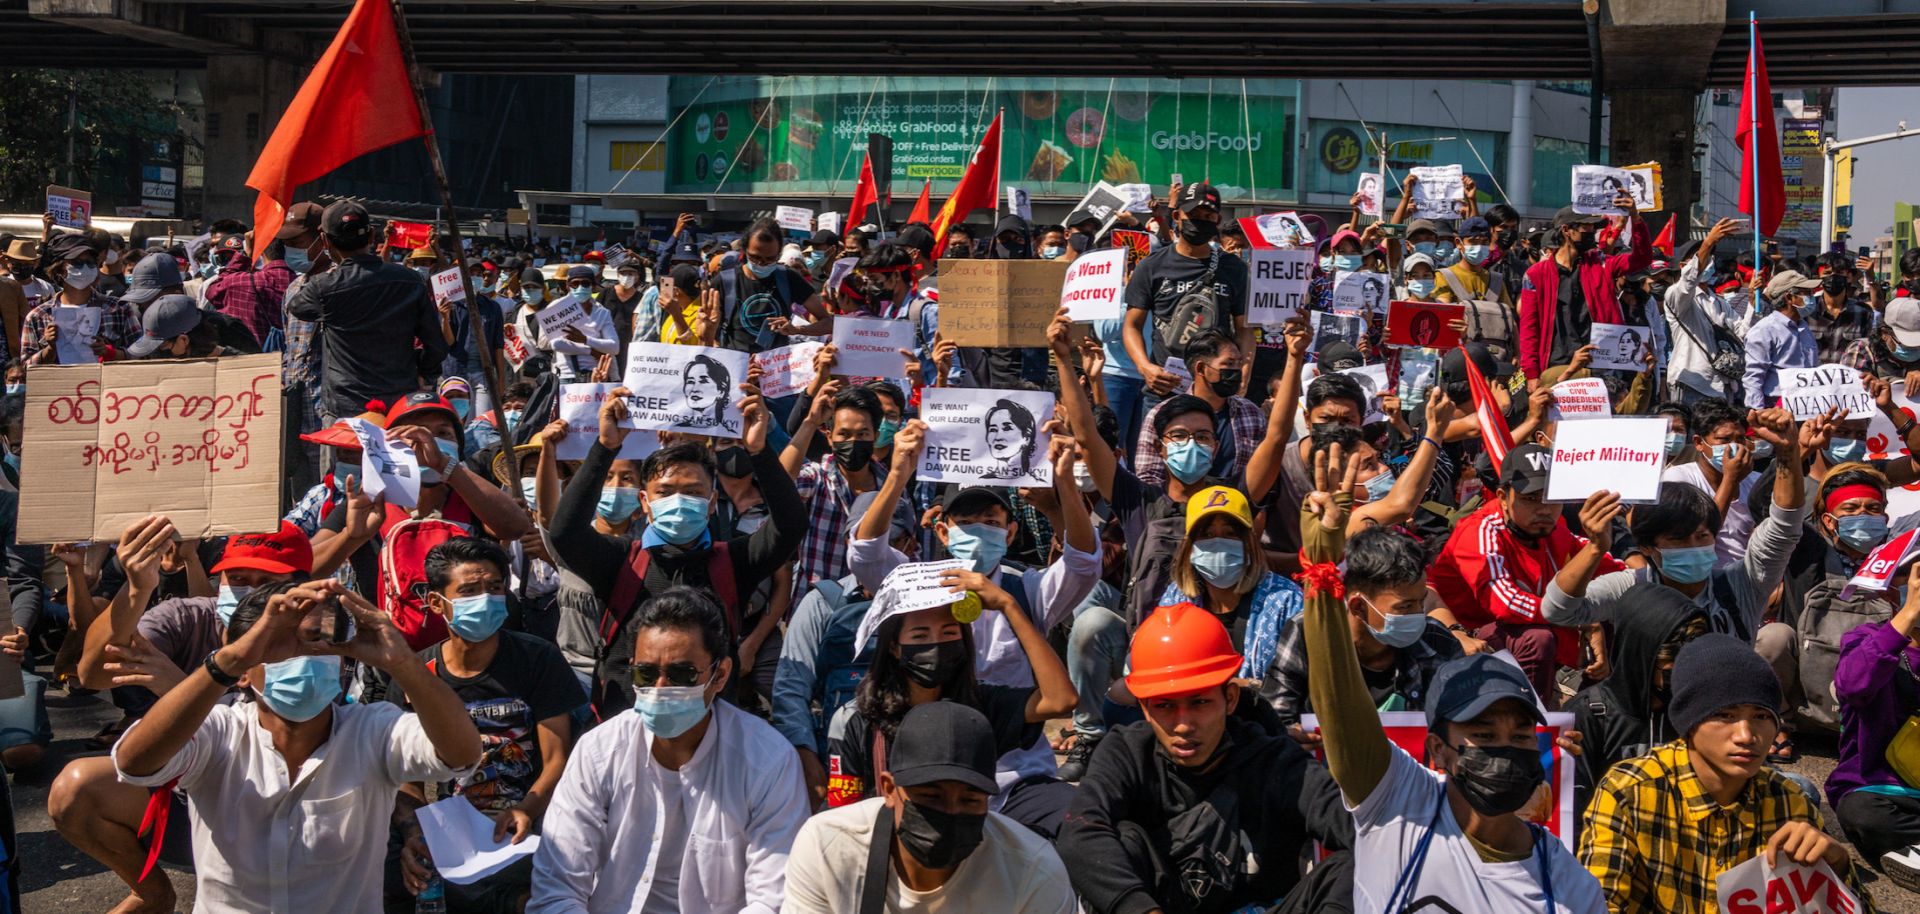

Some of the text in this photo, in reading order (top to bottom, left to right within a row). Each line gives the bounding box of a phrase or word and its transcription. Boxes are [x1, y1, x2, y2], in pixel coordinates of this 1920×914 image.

[900, 121, 956, 133] GrabFood
[898, 143, 914, 151] OFF
[921, 142, 940, 151] Free
[1152, 130, 1261, 151] GrabFood
[892, 154, 955, 163] GrabFood orders
[911, 167, 962, 175] NEWFOODIE
[49, 209, 70, 220] FREE
[1078, 261, 1112, 277] Want
[438, 272, 458, 285] Free
[542, 303, 579, 326] WE WANT
[546, 312, 584, 334] DEMOCRACY
[870, 330, 890, 338] NEED
[633, 355, 670, 364] WE WANT
[648, 367, 680, 376] LEADER
[1796, 368, 1854, 388] SAVE
[566, 393, 592, 404] Save
[626, 395, 668, 411] FREE
[1785, 393, 1872, 416] MYANMAR
[930, 402, 969, 411] WE WANT
[1560, 404, 1603, 413] MOVEMENT
[650, 413, 680, 422] AUNG
[681, 415, 705, 425] SAN
[706, 417, 720, 427] SU
[928, 415, 981, 424] OUR LEADER
[926, 446, 971, 462] FREE
[1555, 447, 1660, 466] Reject Military
[925, 462, 951, 472] DAW
[952, 463, 984, 475] AUNG
[986, 466, 1009, 476] SAN
[1010, 467, 1025, 477] SU
[1727, 869, 1856, 914] SAVE
